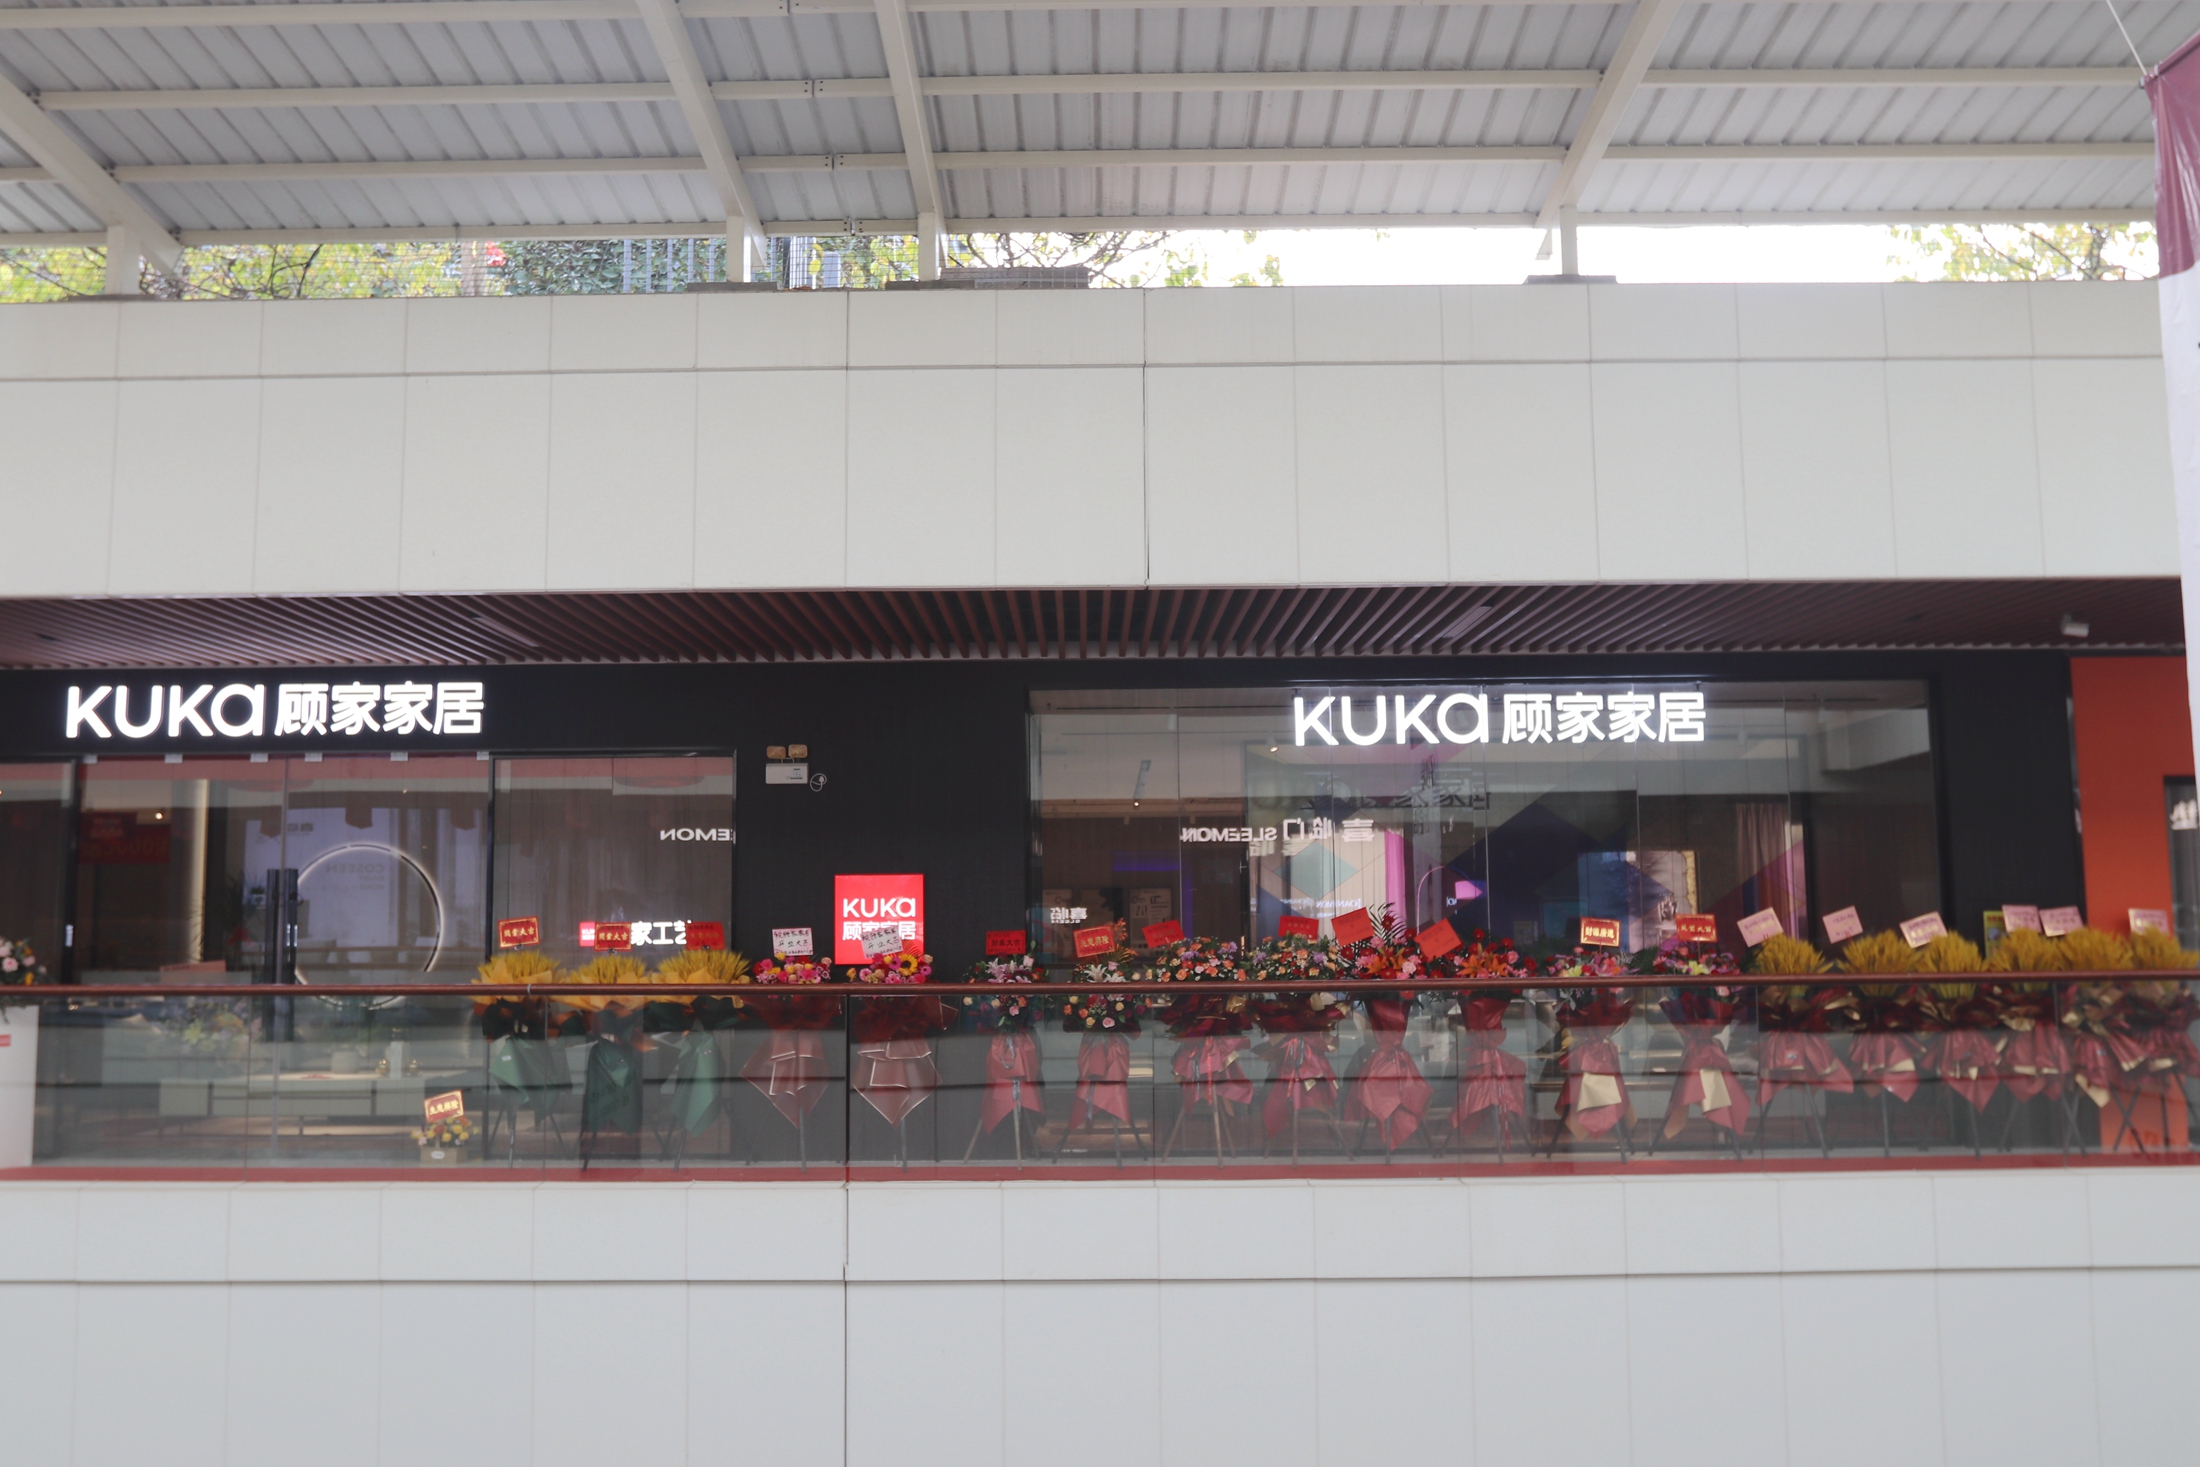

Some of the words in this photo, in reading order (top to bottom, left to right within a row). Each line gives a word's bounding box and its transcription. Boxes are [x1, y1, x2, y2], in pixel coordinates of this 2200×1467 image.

[274, 681, 485, 736] 顾家家居
[1502, 691, 1707, 744] 顾家家居
